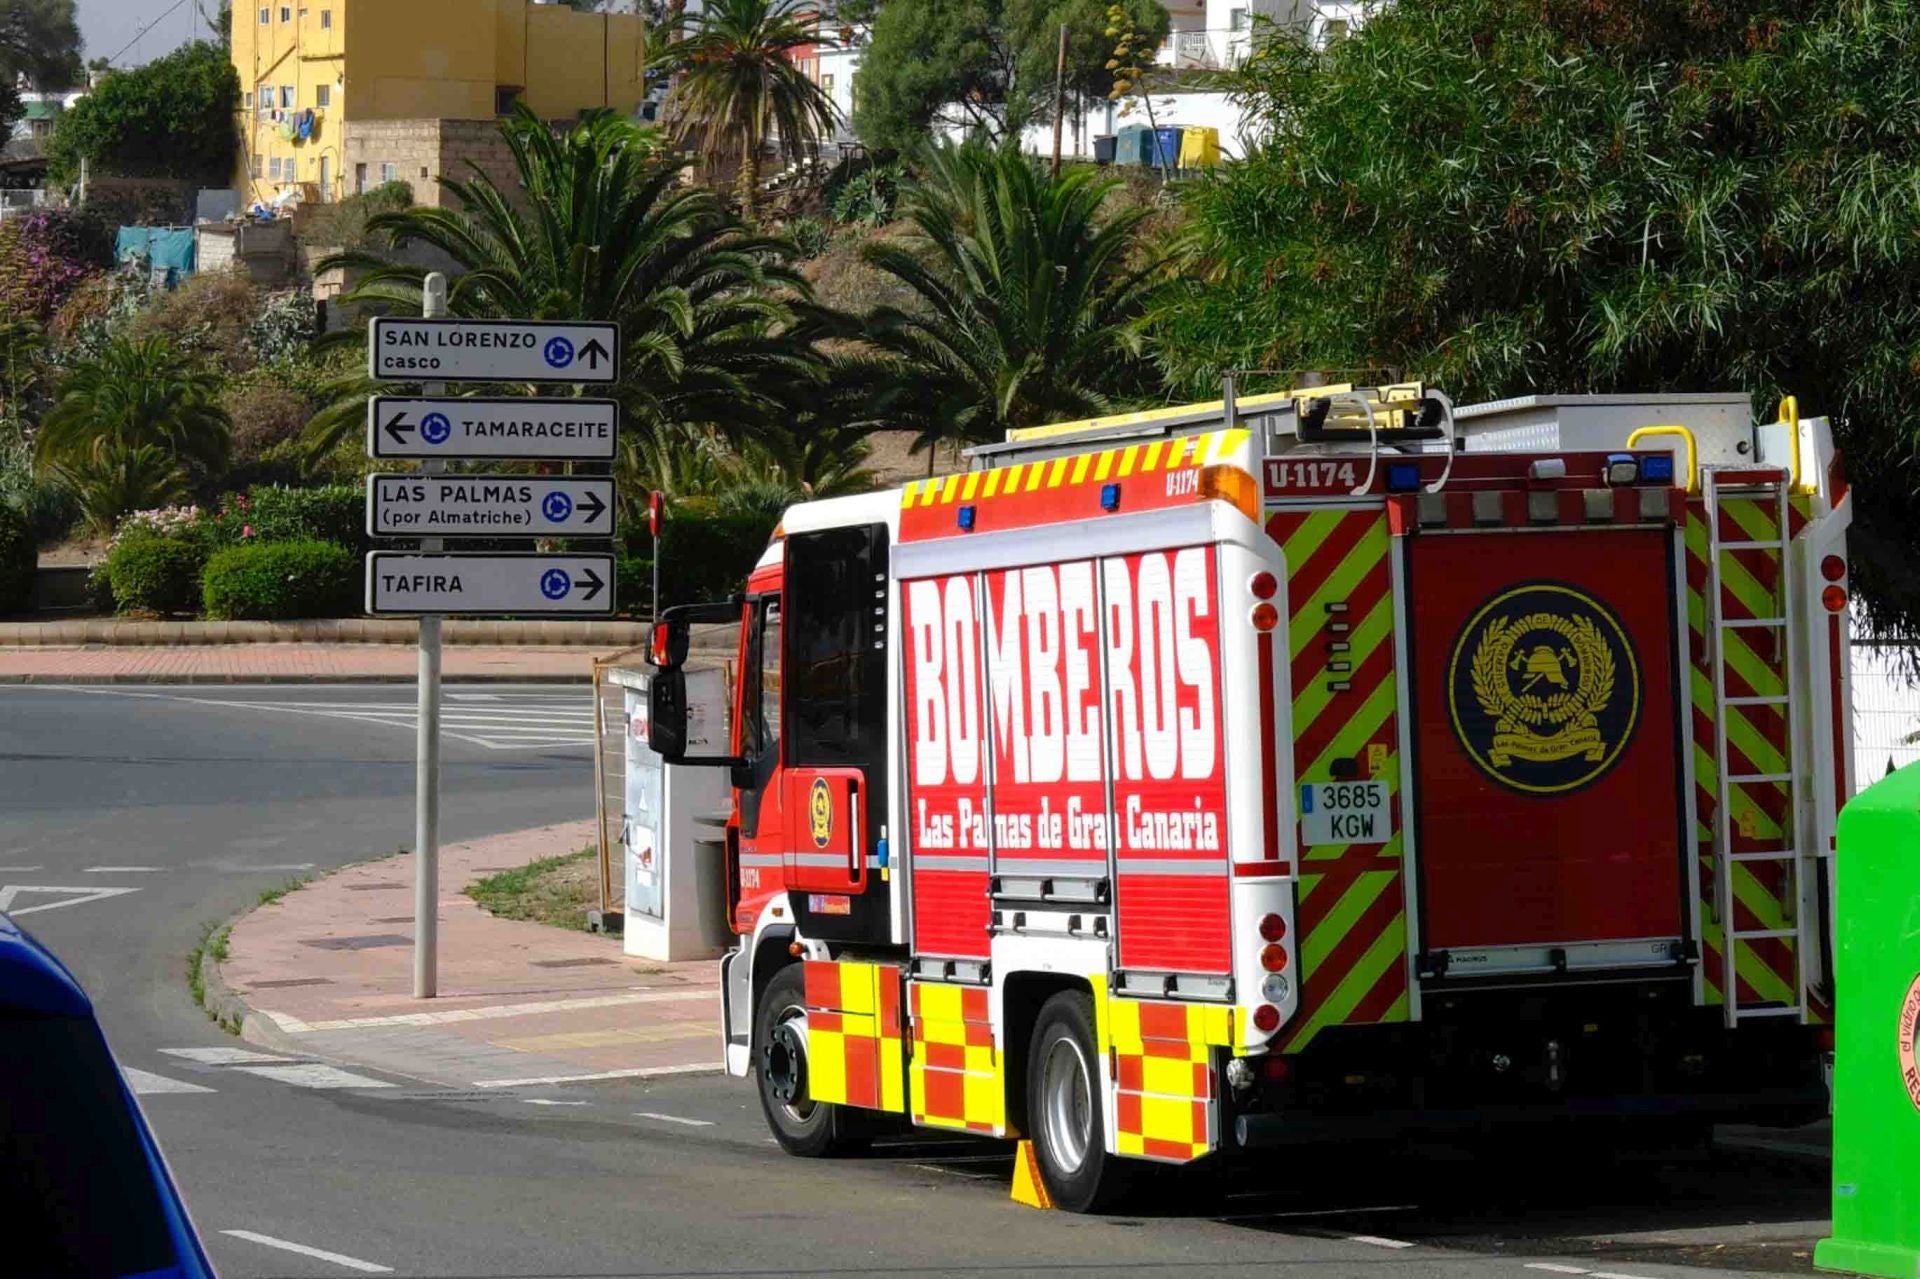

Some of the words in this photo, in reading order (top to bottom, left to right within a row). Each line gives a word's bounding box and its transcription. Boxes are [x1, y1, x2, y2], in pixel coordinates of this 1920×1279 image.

[385, 330, 429, 347] SAN
[437, 331, 537, 349] LORENZO
[384, 356, 441, 369] casco
[461, 420, 609, 438] TAMARACEITE
[1269, 462, 1356, 488] U-1174
[382, 485, 426, 502] LAS
[440, 485, 533, 503] PALMAS
[382, 508, 421, 527] (por
[427, 508, 533, 527] Almatriche)
[382, 575, 464, 593] TAFIRA
[909, 546, 1215, 786] BOMBEROS
[1323, 784, 1381, 809] 3685
[917, 797, 954, 849] Las
[1038, 796, 1064, 849] de
[1068, 796, 1121, 850] Gran
[1126, 794, 1220, 852] Canaria
[1331, 814, 1374, 839] KGW
